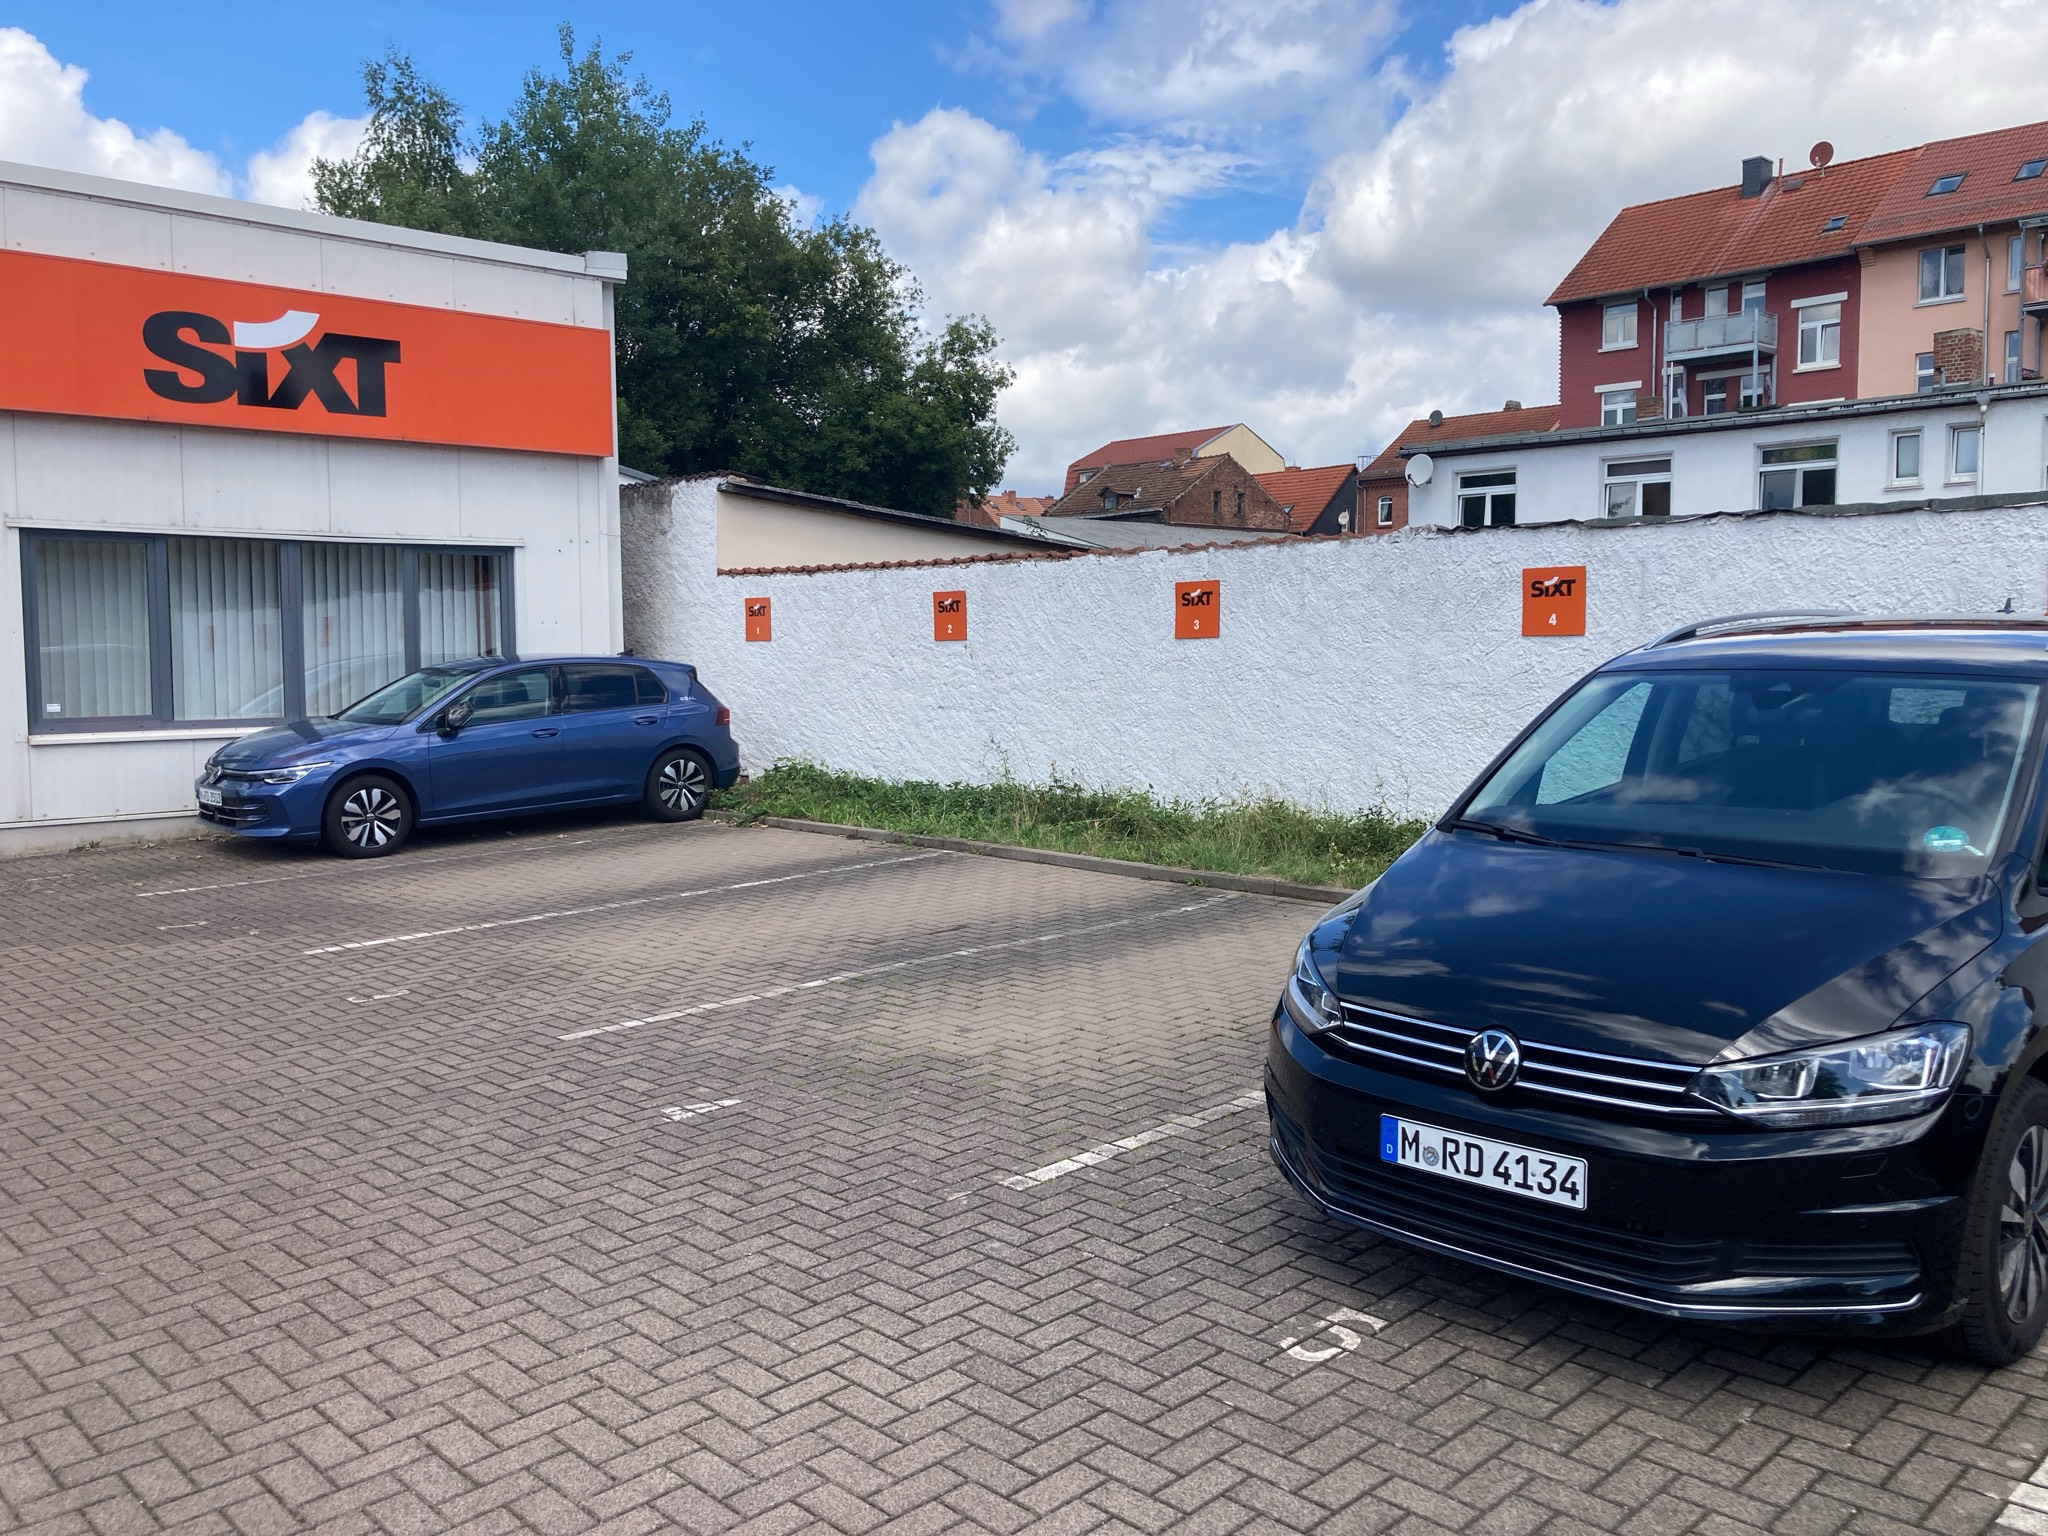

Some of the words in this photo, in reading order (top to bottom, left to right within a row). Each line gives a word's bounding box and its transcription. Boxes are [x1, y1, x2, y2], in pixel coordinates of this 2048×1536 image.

[1193, 619, 1200, 630] 3
[1548, 613, 1557, 626] 4
[756, 626, 760, 635] 1
[947, 624, 953, 634] 2
[1386, 1143, 1394, 1154] D
[1401, 1126, 1420, 1163] M
[1442, 1136, 1484, 1178] RD
[1492, 1150, 1580, 1201] 4134
